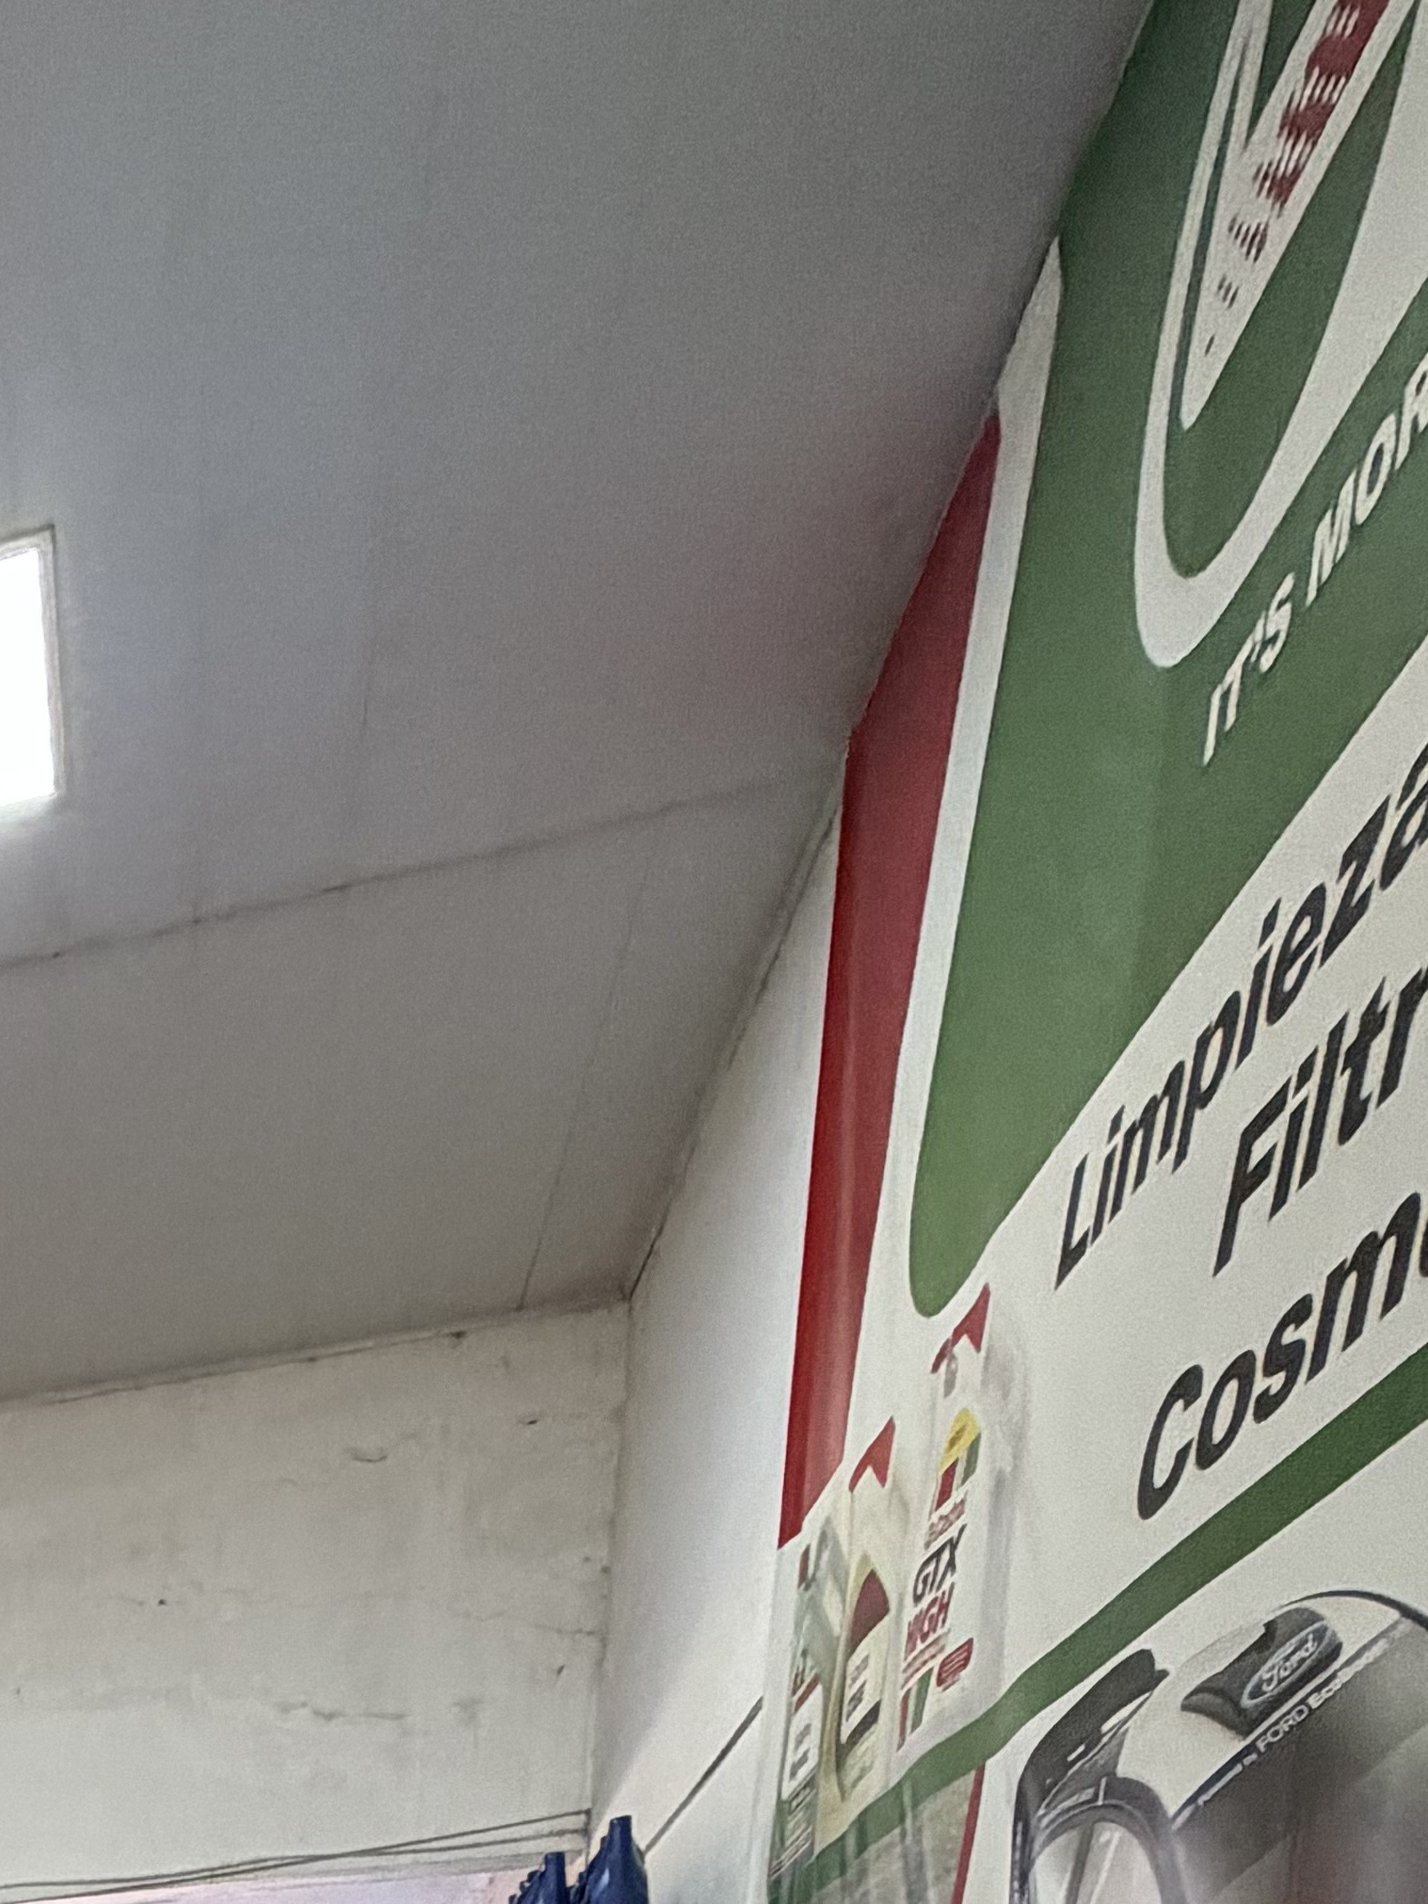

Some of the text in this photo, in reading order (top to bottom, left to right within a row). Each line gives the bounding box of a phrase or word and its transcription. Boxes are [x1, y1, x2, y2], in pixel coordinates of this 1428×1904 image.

[1202, 572, 1296, 767] IT'S
[1137, 1191, 1428, 1520] Cosm
[913, 1524, 967, 1605] GTX
[1261, 1634, 1318, 1692] Ford
[1256, 1704, 1309, 1753] FORD
